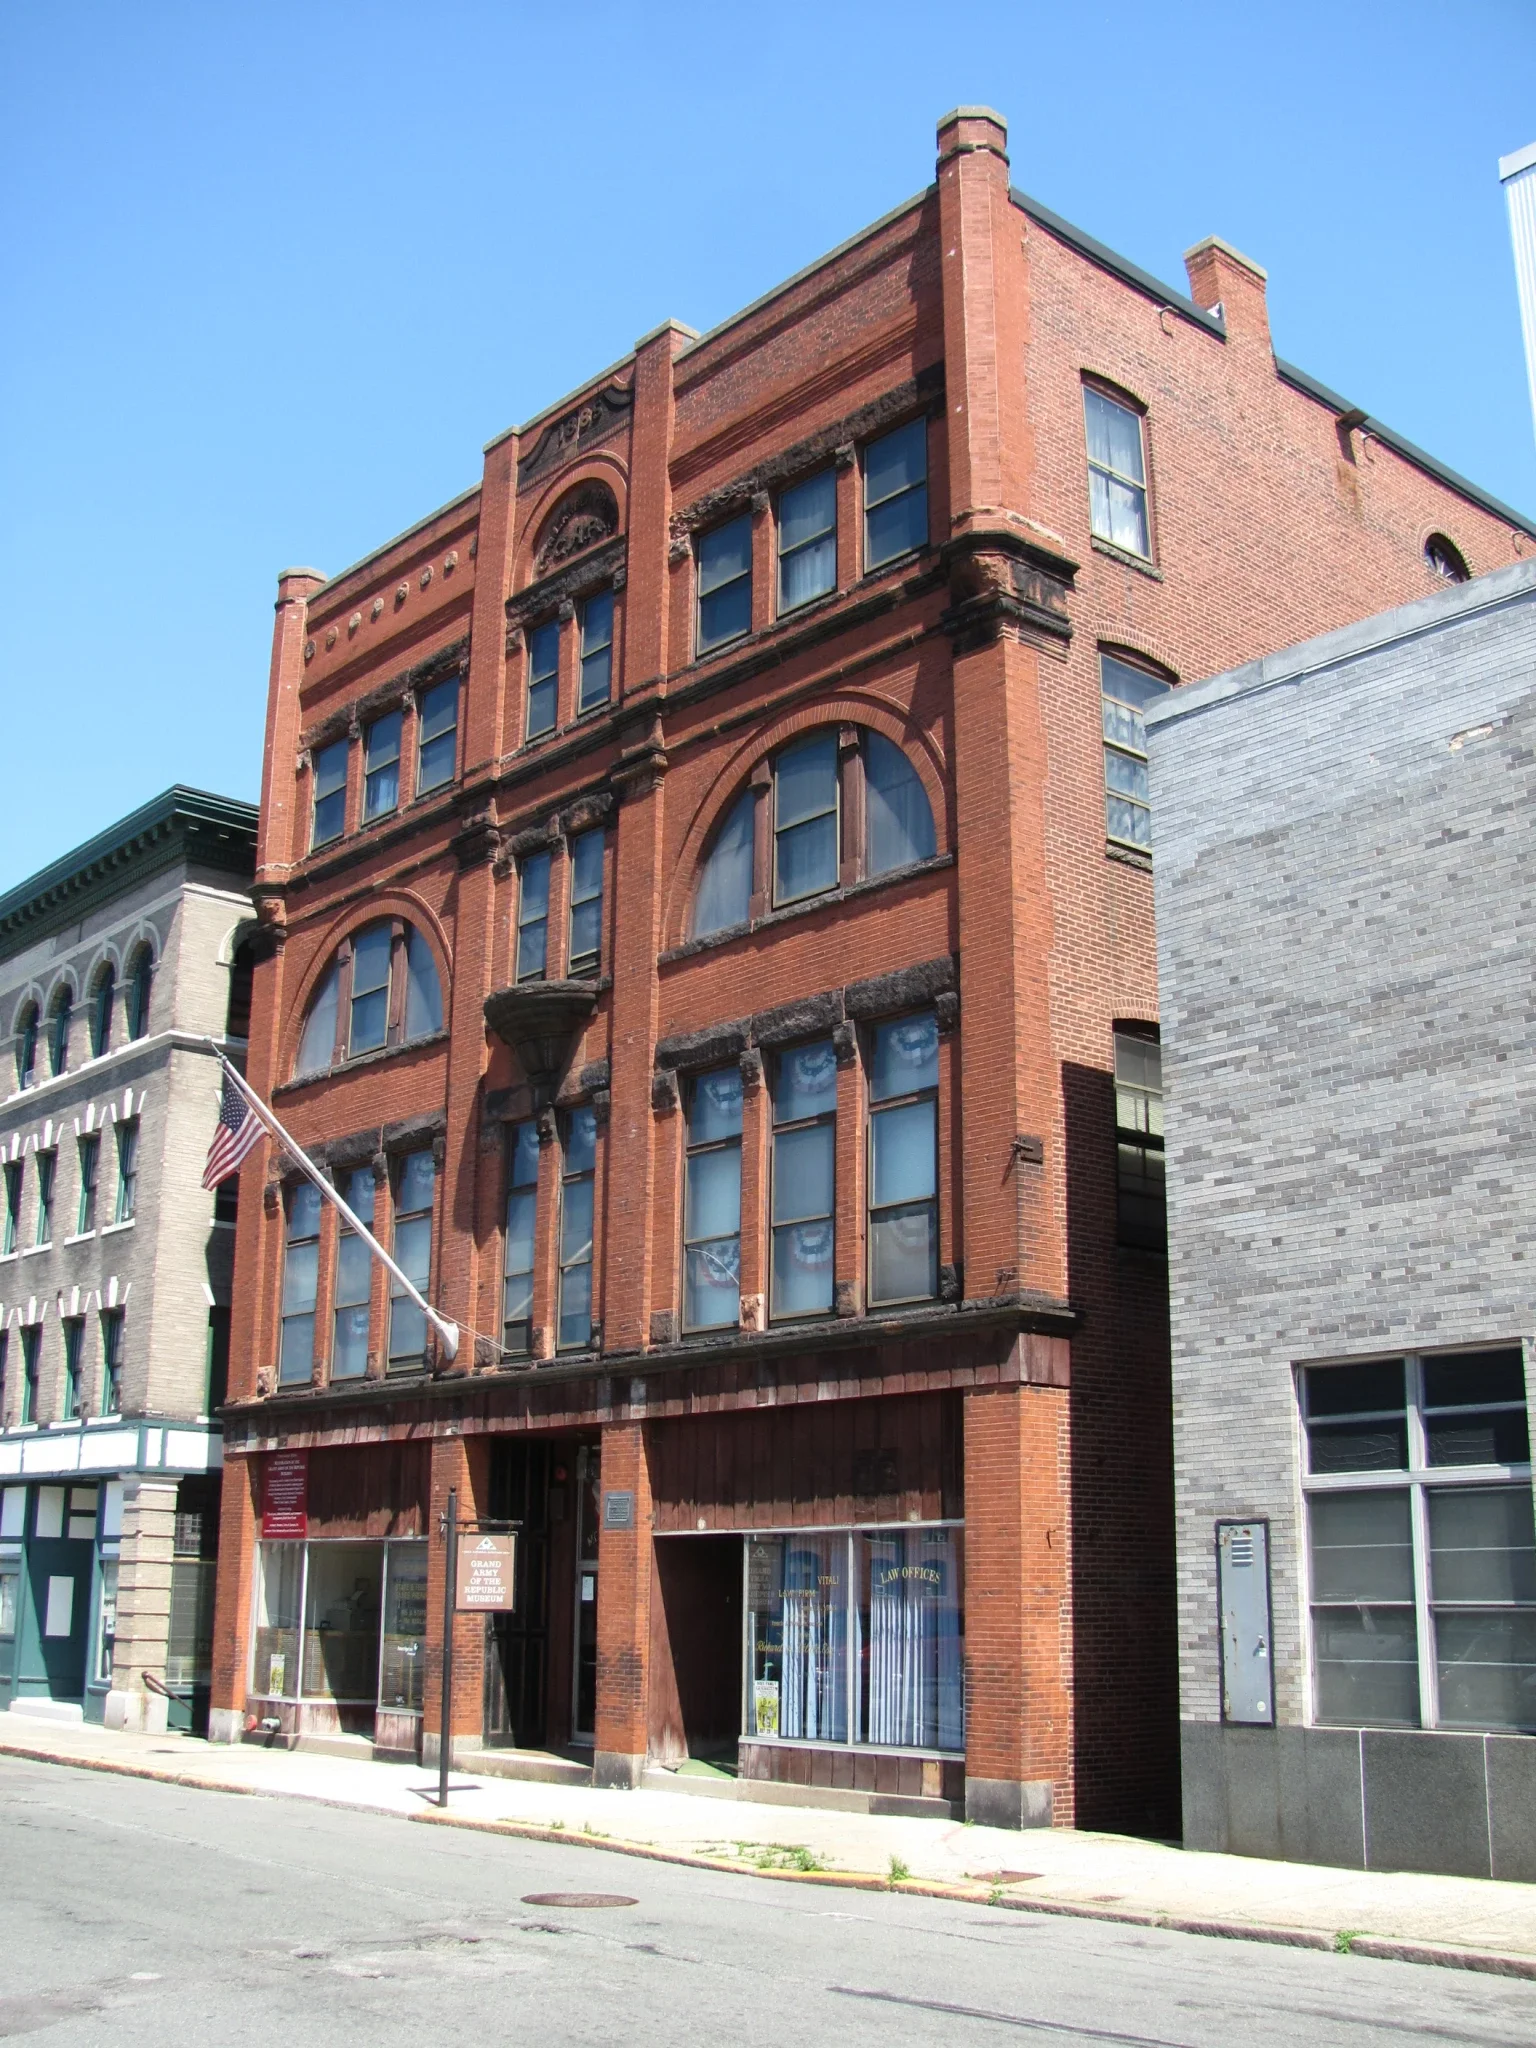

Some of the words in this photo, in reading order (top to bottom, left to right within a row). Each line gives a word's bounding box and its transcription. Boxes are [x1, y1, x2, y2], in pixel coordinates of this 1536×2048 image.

[557, 398, 603, 447] 1885
[470, 1560, 502, 1568] GRAND
[472, 1569, 499, 1577] ARMY
[880, 1567, 899, 1584] LAW
[901, 1566, 941, 1583] OFFICES
[470, 1577, 482, 1585] OF
[483, 1577, 502, 1585] THE
[464, 1586, 507, 1594] REPUBLIC
[778, 1589, 793, 1598] LAW
[798, 1589, 816, 1598] FIRM
[466, 1595, 504, 1603] MUSEUM
